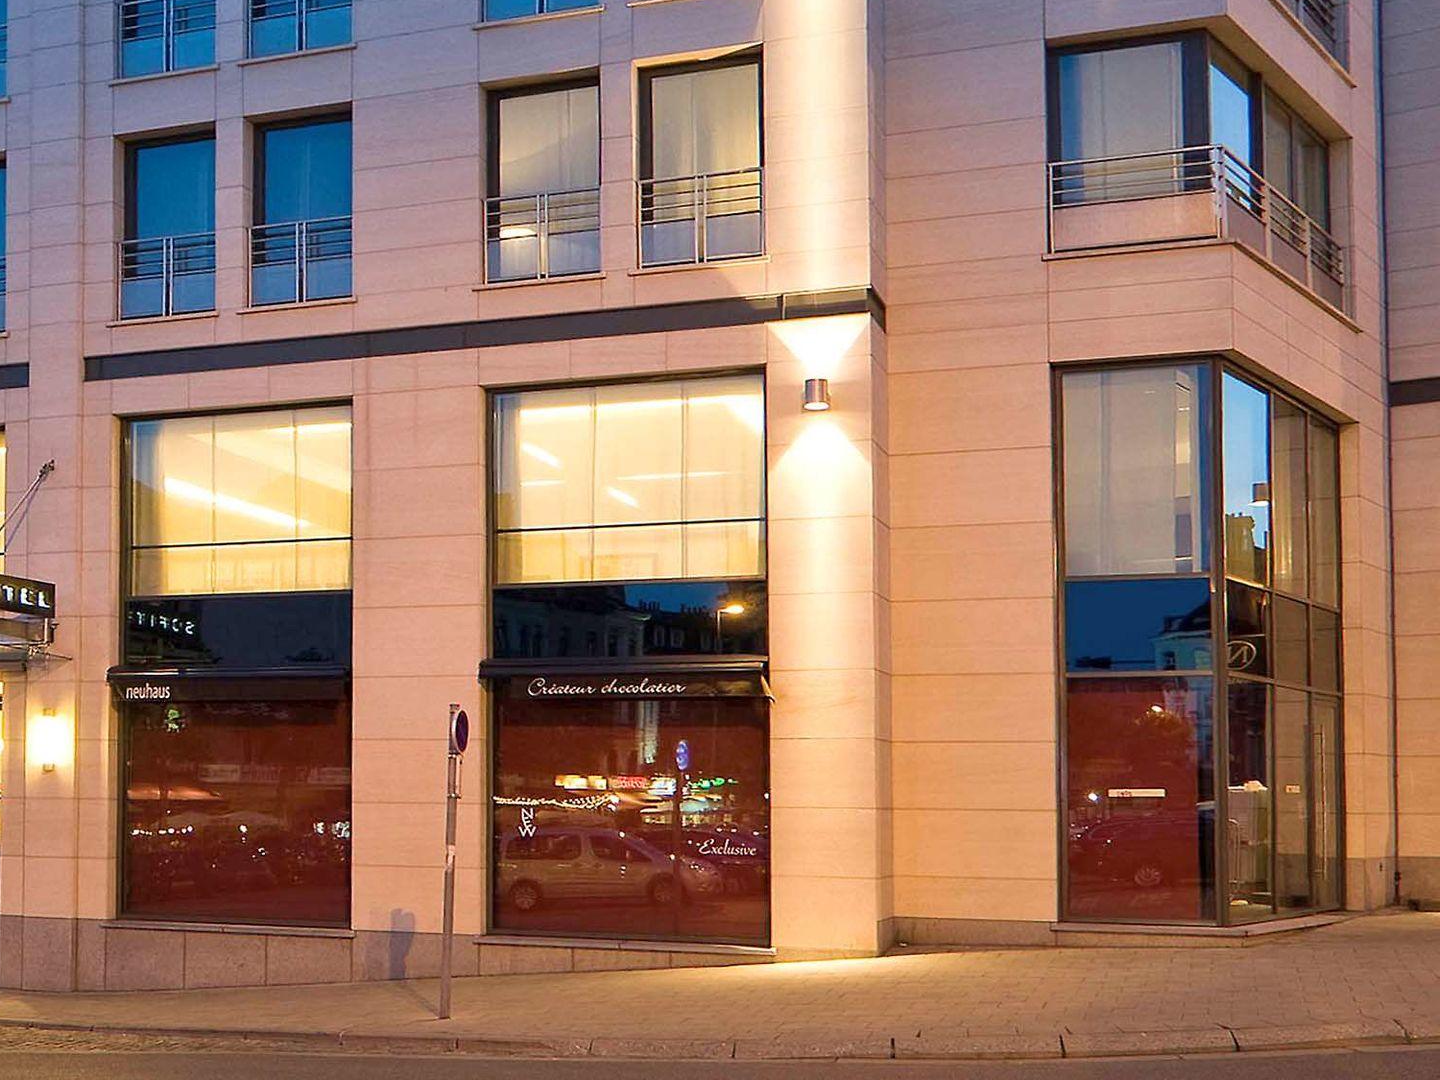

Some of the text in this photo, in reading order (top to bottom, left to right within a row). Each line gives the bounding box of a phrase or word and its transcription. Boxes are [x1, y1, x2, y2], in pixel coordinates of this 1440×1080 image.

[125, 682, 171, 699] neuhaus
[600, 677, 687, 695] chocolatier
[698, 839, 758, 857] Exclusive
